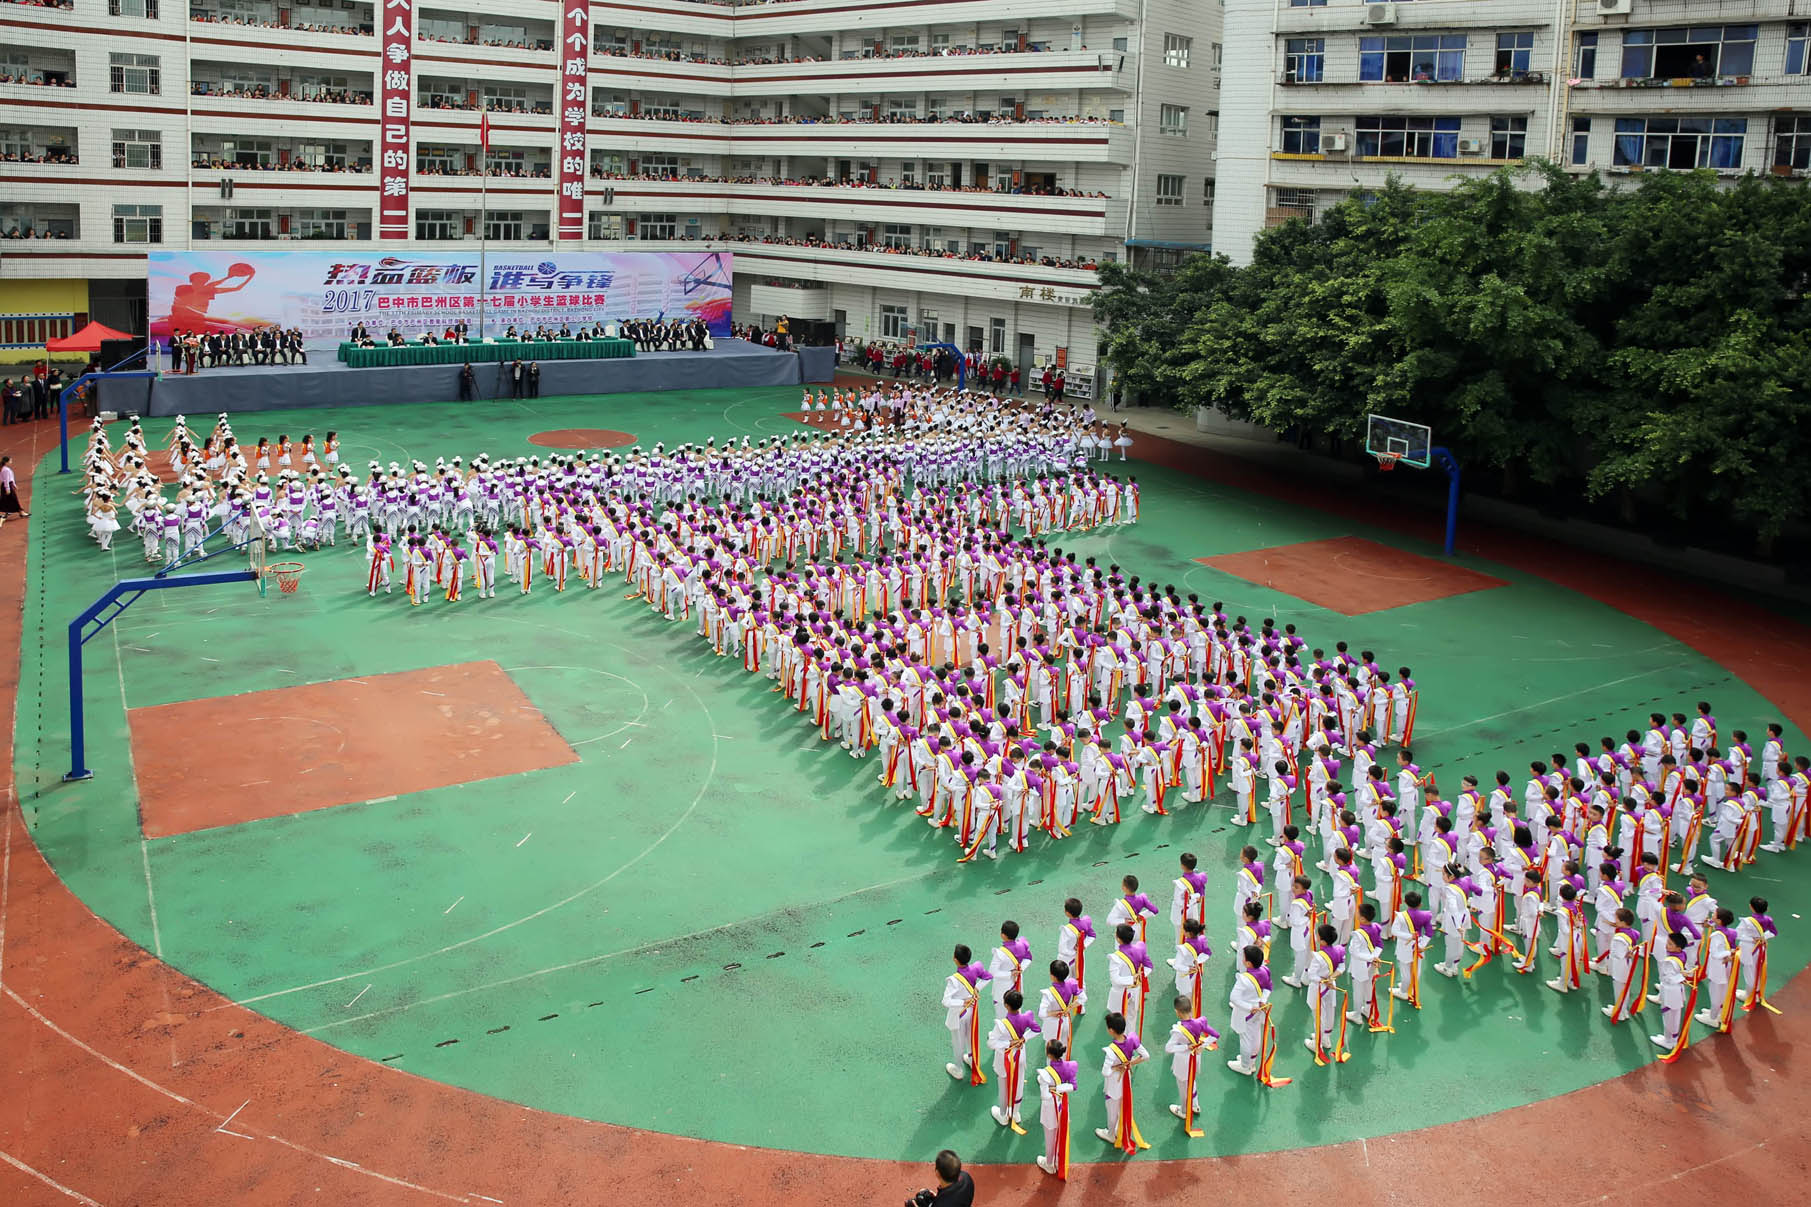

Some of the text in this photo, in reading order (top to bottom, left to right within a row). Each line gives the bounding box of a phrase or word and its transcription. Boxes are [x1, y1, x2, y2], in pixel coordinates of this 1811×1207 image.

[562, 7, 587, 218] 个个成为学校的唯一
[489, 270, 615, 290] 谁与争锋
[322, 290, 376, 312] 2017
[1019, 285, 1057, 303] 南楼
